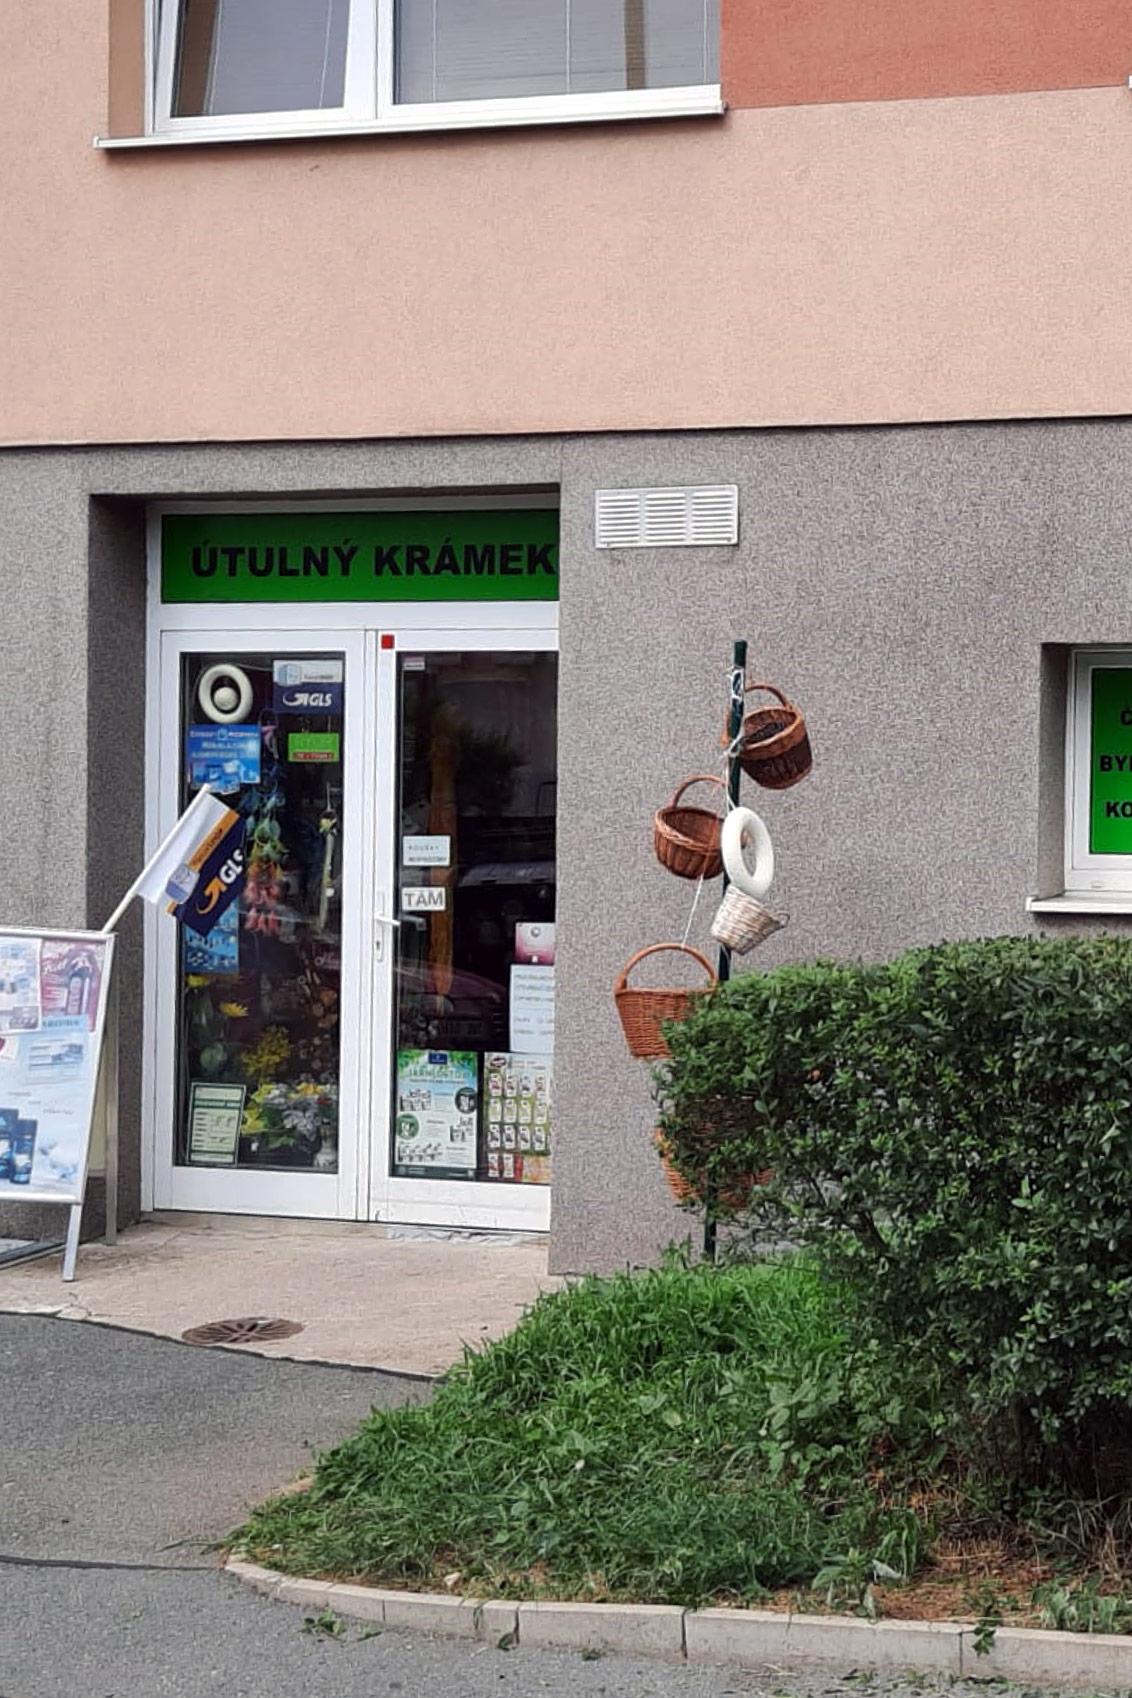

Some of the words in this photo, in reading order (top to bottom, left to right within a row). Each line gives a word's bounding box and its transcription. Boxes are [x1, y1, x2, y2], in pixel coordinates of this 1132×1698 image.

[191, 538, 358, 578] ÚTULNÝ
[373, 536, 557, 577] KRÁMEK
[310, 692, 333, 707] GLS
[403, 890, 444, 908] TAM
